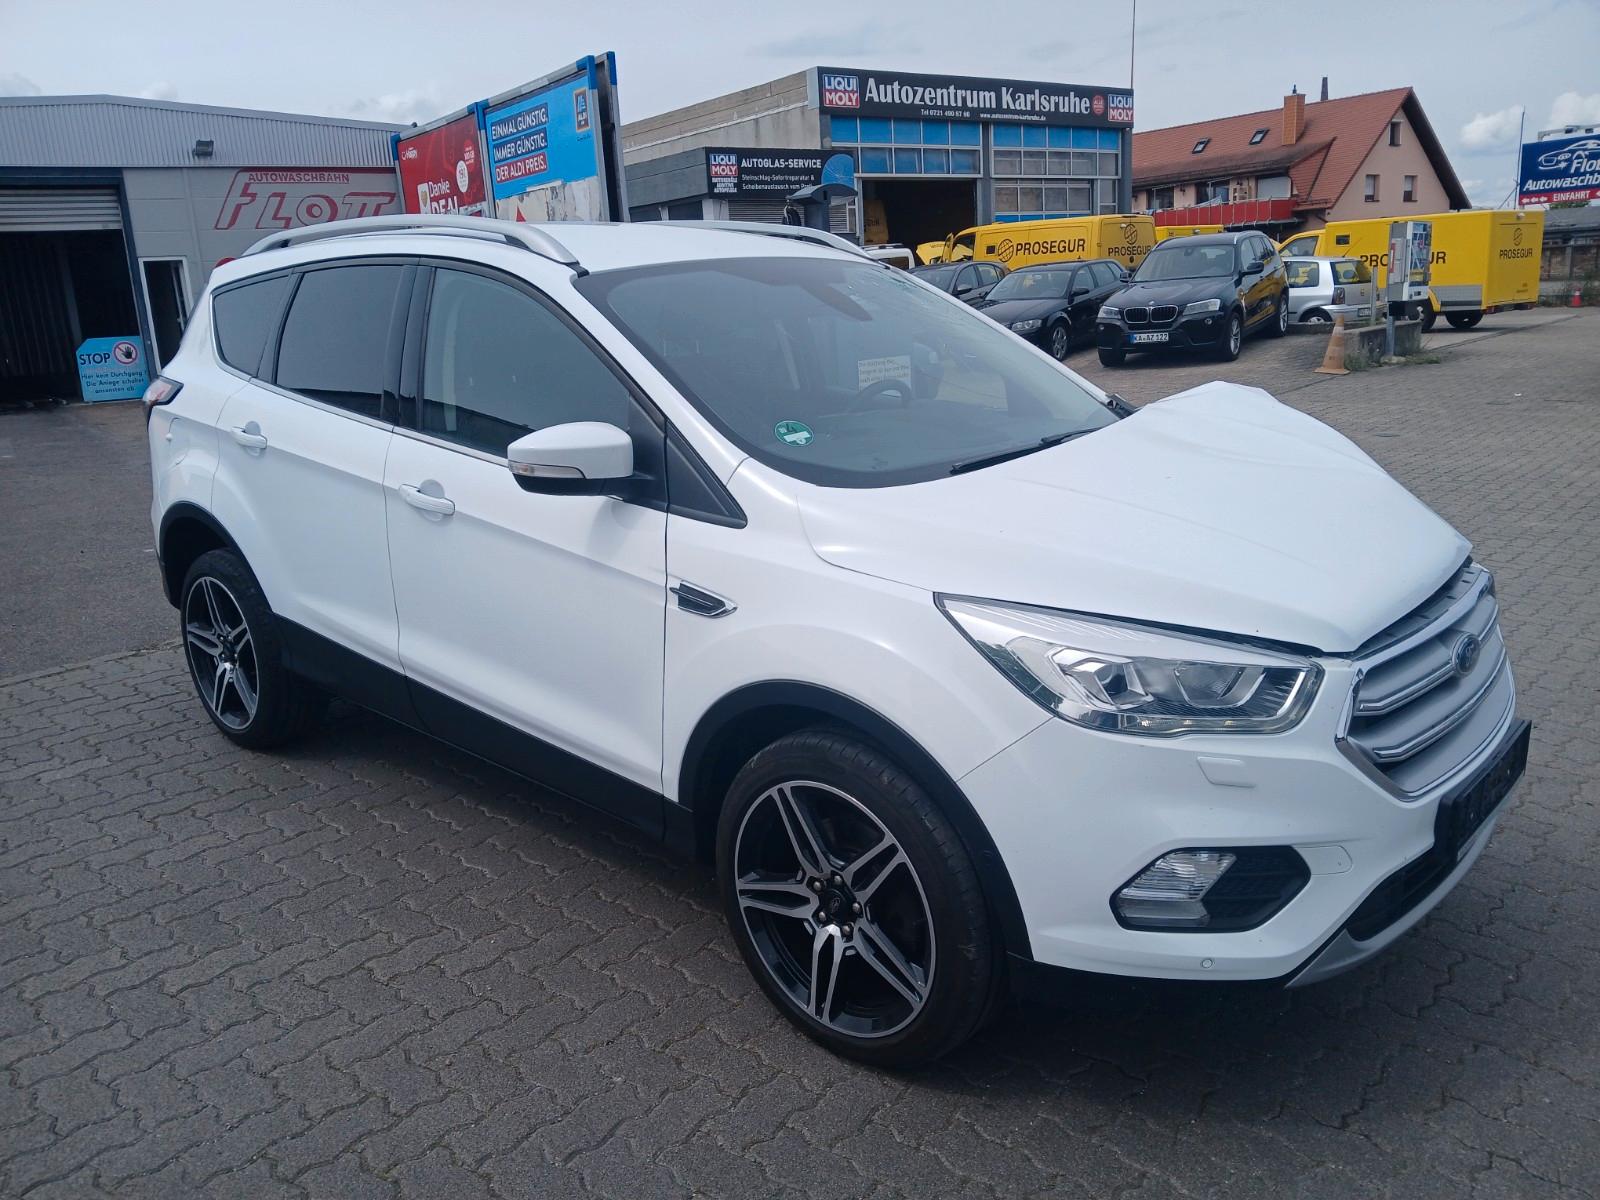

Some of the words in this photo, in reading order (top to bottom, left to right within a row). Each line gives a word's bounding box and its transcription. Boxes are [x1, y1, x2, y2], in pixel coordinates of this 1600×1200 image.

[824, 76, 857, 91] LIQUI
[825, 91, 860, 106] MOLY
[865, 78, 996, 109] Autozentrum
[1001, 86, 1091, 114] Karlsruhe
[1109, 96, 1133, 108] LIQUI
[1110, 108, 1133, 121] MOLY
[491, 122, 517, 140] EINMAL
[517, 108, 548, 129] GÜNSTIG.
[494, 142, 516, 161] IMMER
[516, 133, 547, 154] GÜNSTIG.
[711, 154, 736, 165] LIQUI
[741, 159, 822, 169] AUTOGLAS-SERVICE
[495, 166, 510, 181] DER
[510, 162, 526, 177] ALDI
[526, 155, 547, 173] PREIS.
[711, 165, 738, 175] MOLY
[248, 173, 350, 183] AUTOWASCHBAHN
[428, 178, 450, 197] Danke
[1553, 190, 1591, 201] EINFAHRT
[1015, 238, 1086, 256] PROSEGUR
[1499, 247, 1533, 260] PROSEGUR
[79, 352, 111, 366] STOP
